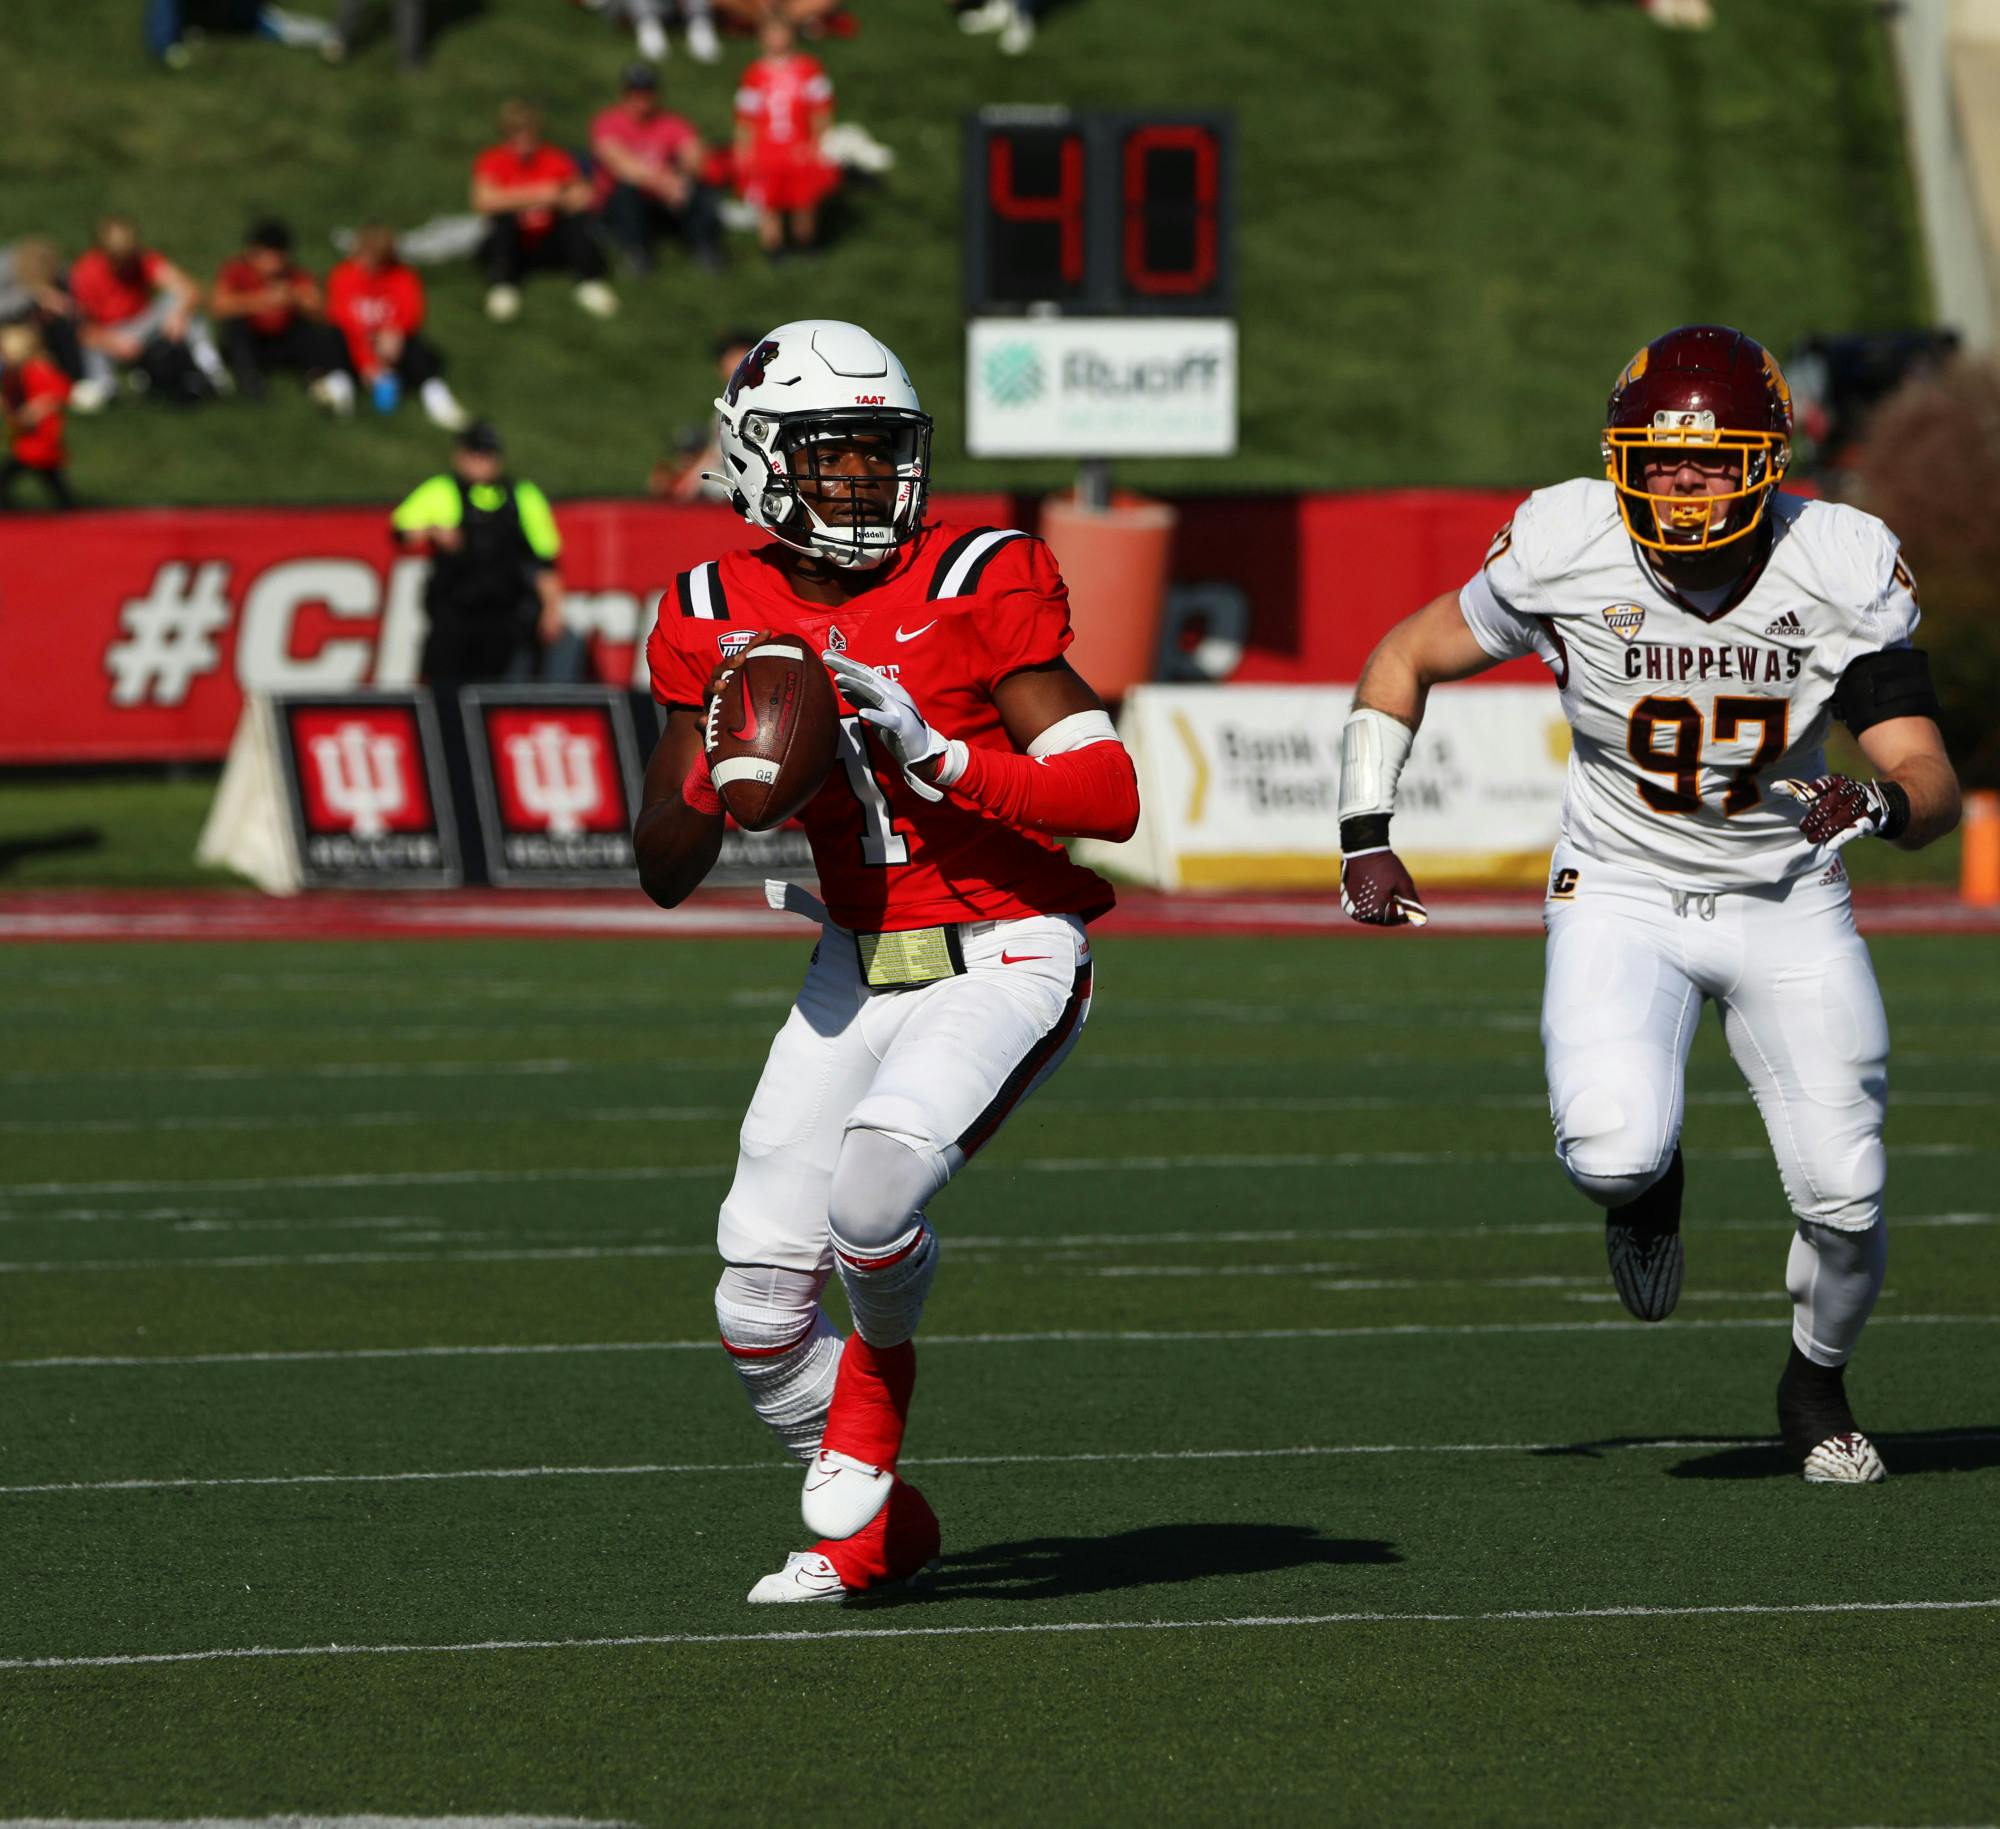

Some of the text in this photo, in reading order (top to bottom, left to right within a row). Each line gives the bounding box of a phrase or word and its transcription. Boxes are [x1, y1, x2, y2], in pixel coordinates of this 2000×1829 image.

[988, 123, 1220, 294] 40
[854, 395, 886, 405] 1AAT
[1764, 625, 1806, 636] adidas
[1624, 645, 1801, 683] CHIPPEWAS
[1626, 695, 1791, 818] 97
[755, 769, 773, 783] QB
[836, 715, 910, 866] 1
